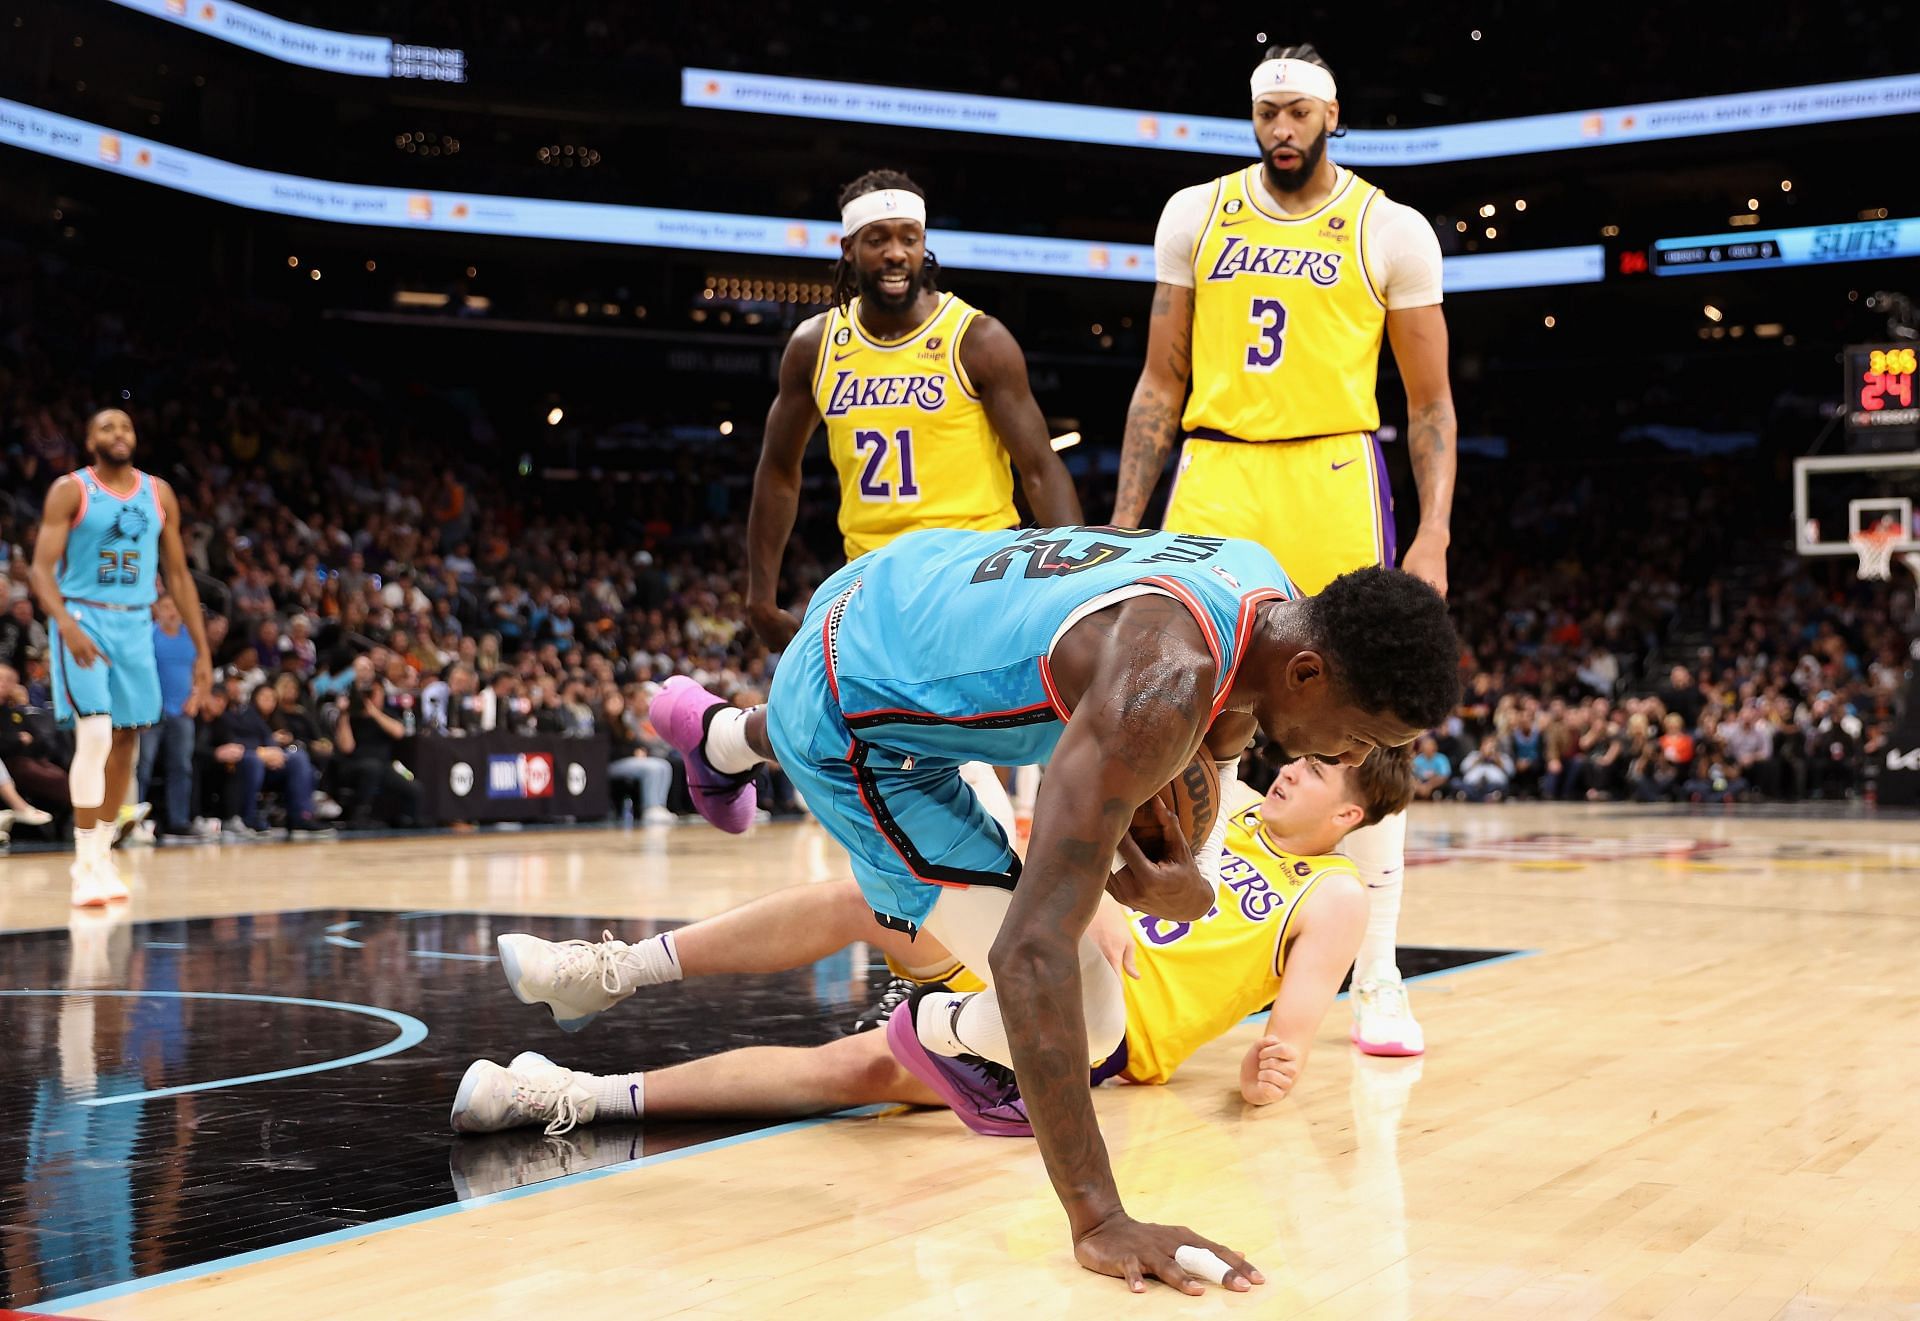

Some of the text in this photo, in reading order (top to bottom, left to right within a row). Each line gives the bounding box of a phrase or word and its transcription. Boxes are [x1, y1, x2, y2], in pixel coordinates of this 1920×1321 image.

[1207, 237, 1342, 286] LAKERS
[1246, 298, 1287, 368] 3
[824, 370, 947, 416] LAKERS
[1861, 371, 1912, 411] 24
[854, 428, 919, 498] 21
[98, 550, 139, 585] 25
